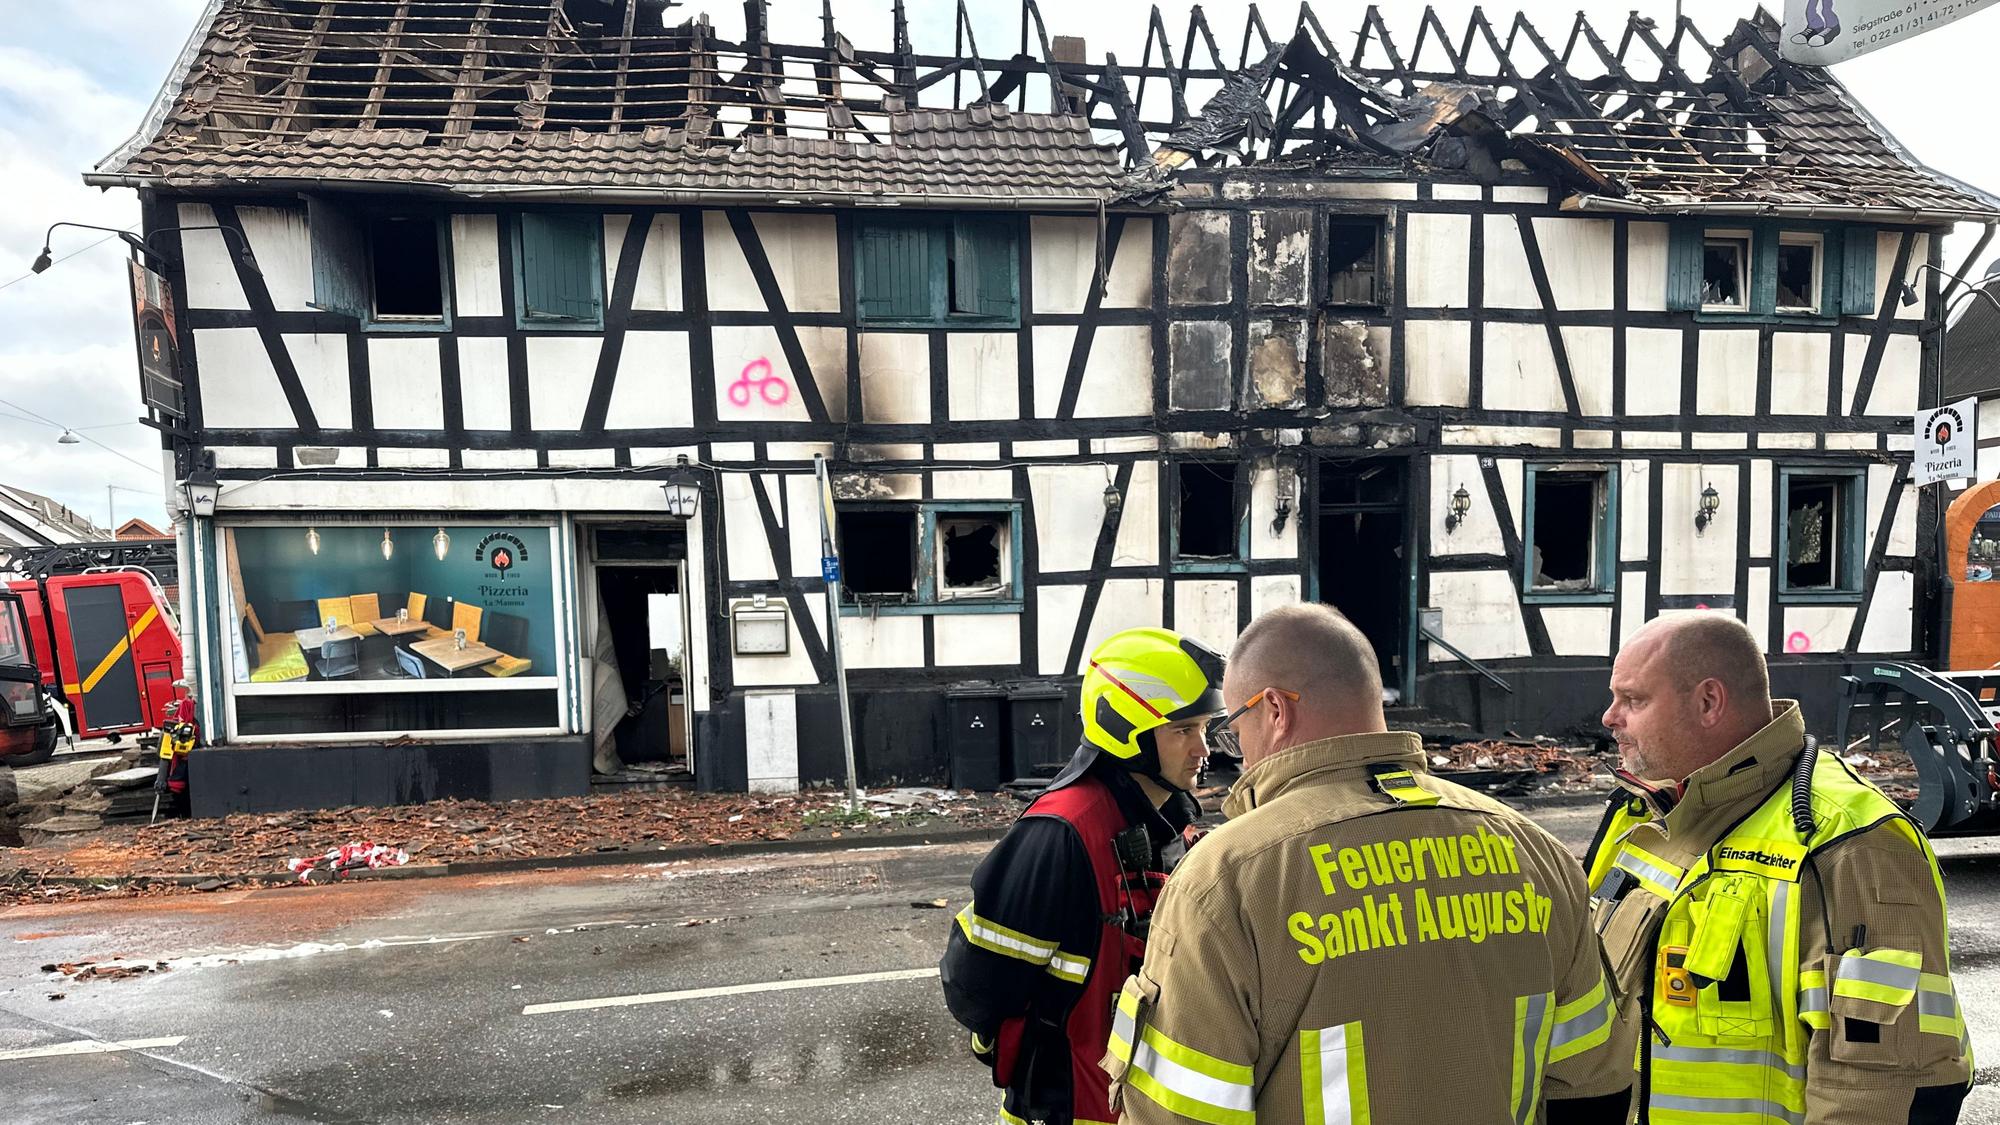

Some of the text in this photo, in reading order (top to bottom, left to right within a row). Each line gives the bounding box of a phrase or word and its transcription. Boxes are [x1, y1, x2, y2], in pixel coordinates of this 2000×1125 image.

[1852, 2, 1917, 34] Siegstraße 61
[1925, 458, 1962, 473] Pizzeria
[477, 585, 529, 597] Pizzeria
[1309, 825, 1520, 896] Feuerwehr
[1287, 892, 1408, 965] Sankt
